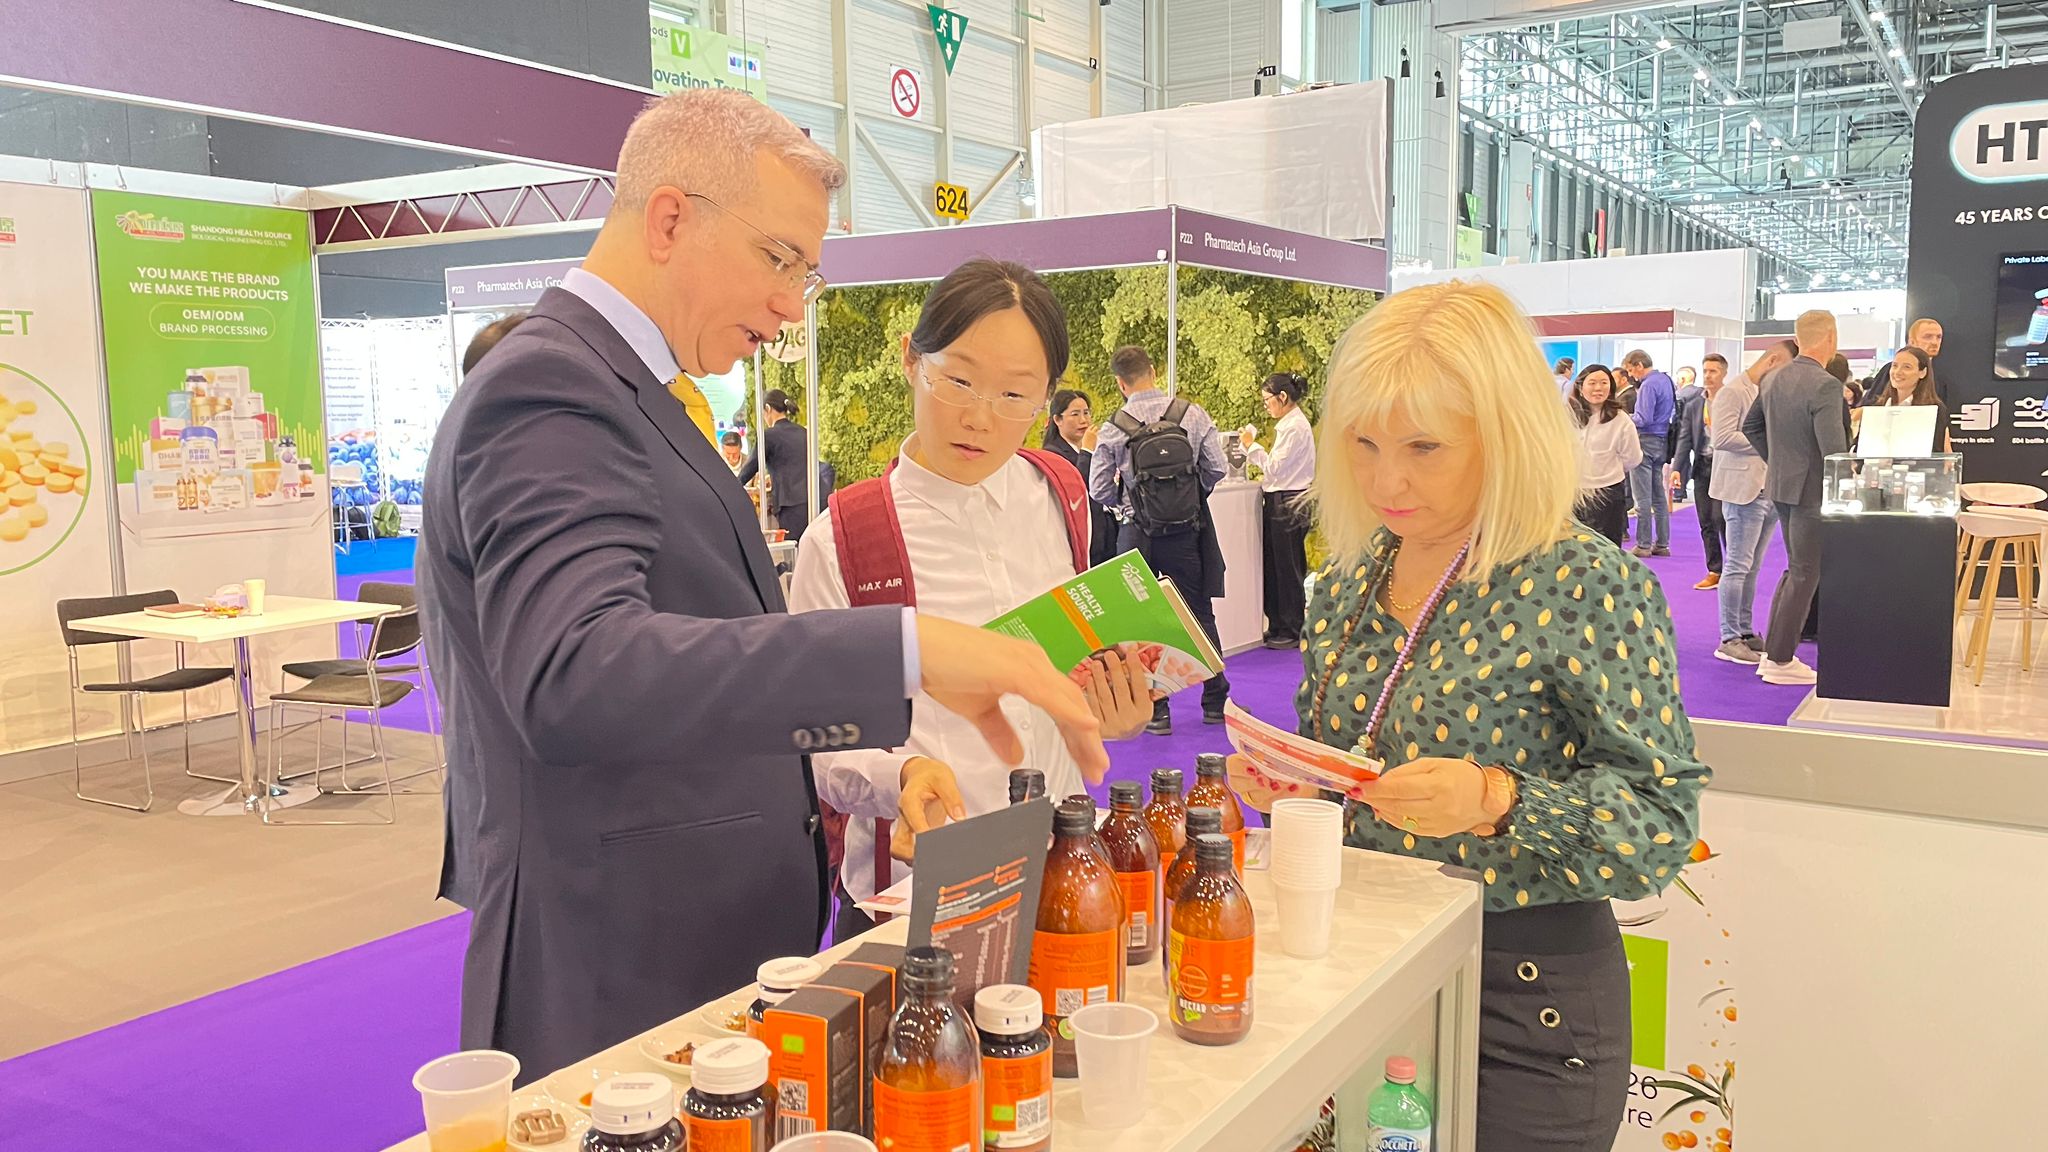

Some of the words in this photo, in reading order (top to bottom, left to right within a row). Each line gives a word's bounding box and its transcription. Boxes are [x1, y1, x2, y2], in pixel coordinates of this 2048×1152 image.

[936, 186, 968, 216] 624
[1954, 212, 1976, 225] 45
[1980, 207, 2032, 224] YEARS
[190, 224, 234, 234] SHANDONG
[234, 228, 263, 237] HEALTH
[264, 230, 292, 240] SOURCE
[1180, 232, 1194, 244] P222
[1204, 232, 1246, 252] Pharmatech
[1246, 240, 1261, 256] Asia
[1262, 242, 1284, 263] Group
[136, 266, 167, 280] YOU
[170, 268, 208, 282] MAKE
[210, 272, 234, 284] THE
[237, 273, 280, 286] BRAND
[477, 278, 524, 293] Pharmatech
[526, 278, 542, 290] Asia
[129, 282, 152, 294] WE
[154, 283, 192, 296] MAKE
[195, 286, 220, 297] THE
[222, 287, 288, 301] PRODUCTS
[0, 310, 34, 336] ET
[182, 309, 244, 322] OEM/ODM
[160, 322, 198, 334] BRAND
[202, 324, 268, 336] PROCESSING
[858, 580, 881, 592] MAX
[885, 578, 902, 588] AIR
[1066, 588, 1095, 622] SOURCE
[1076, 582, 1104, 616] HEALTH
[1628, 1072, 1658, 1100] 26
[1628, 1108, 1652, 1128] re
